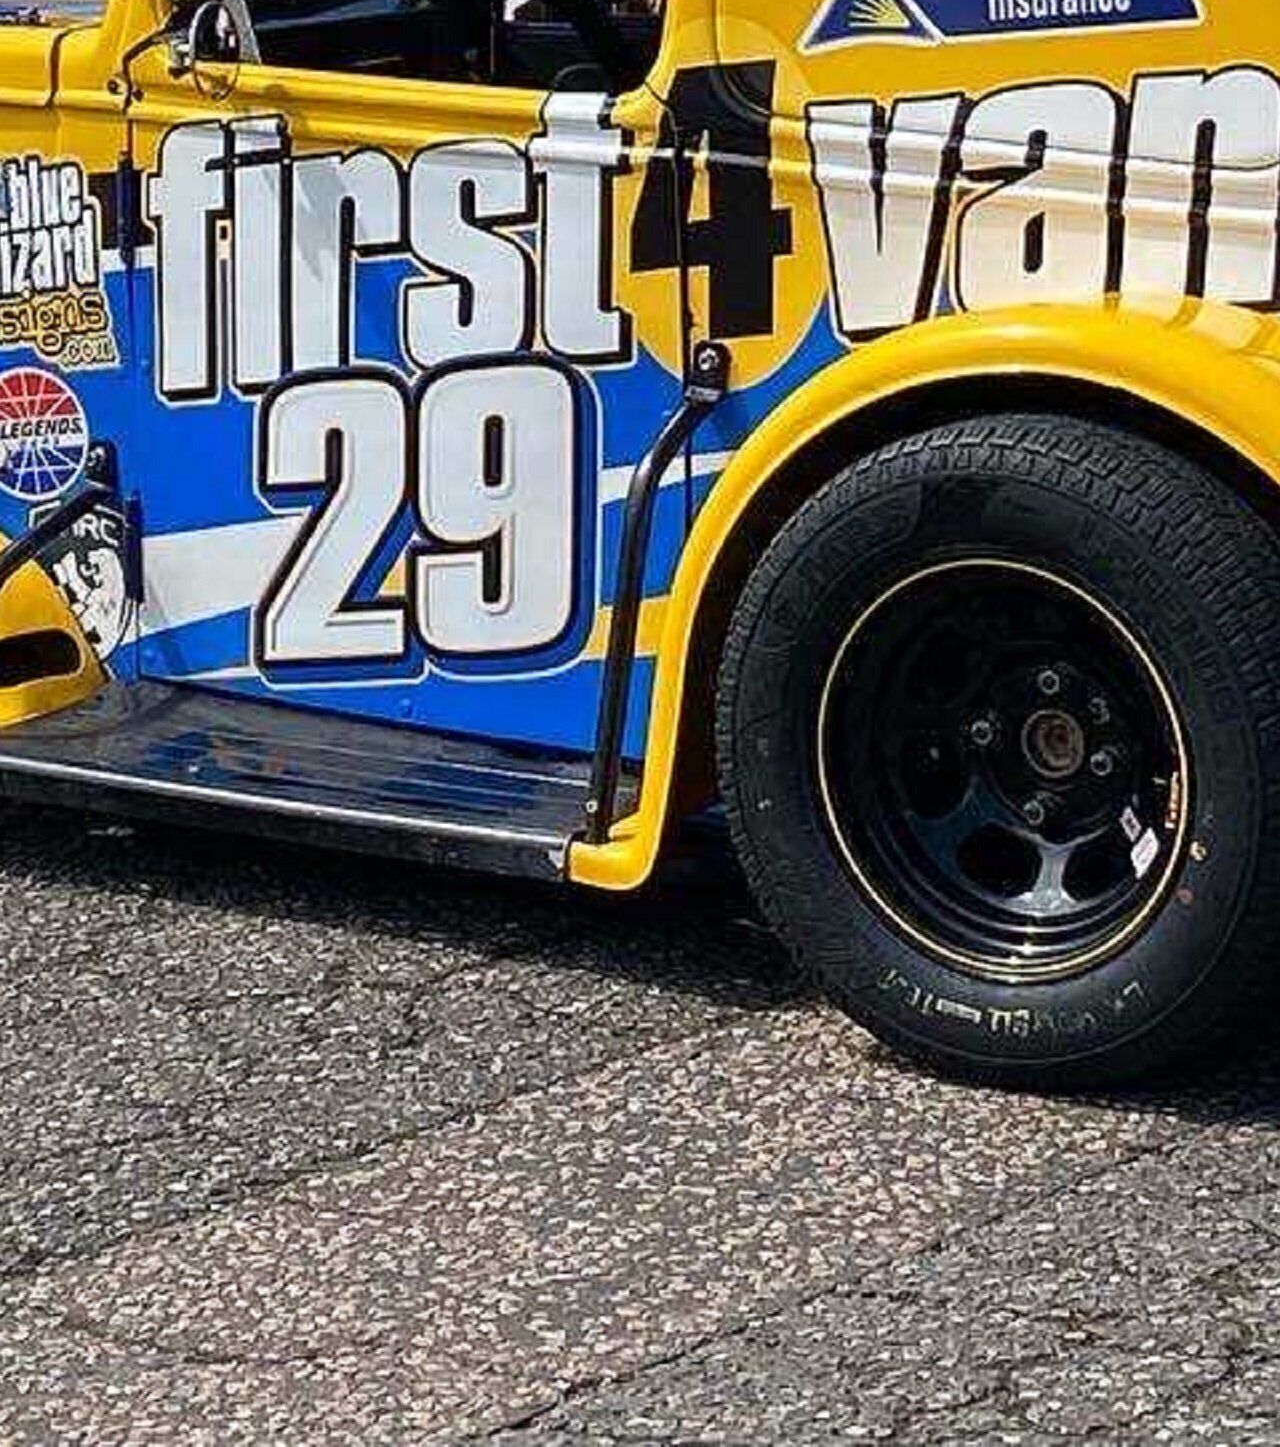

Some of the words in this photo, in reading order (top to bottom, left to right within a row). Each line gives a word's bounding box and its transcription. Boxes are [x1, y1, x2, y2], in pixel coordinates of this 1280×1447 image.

[6, 159, 82, 230] blue
[1, 416, 85, 440] LEGENDS
[260, 358, 592, 672] 29
